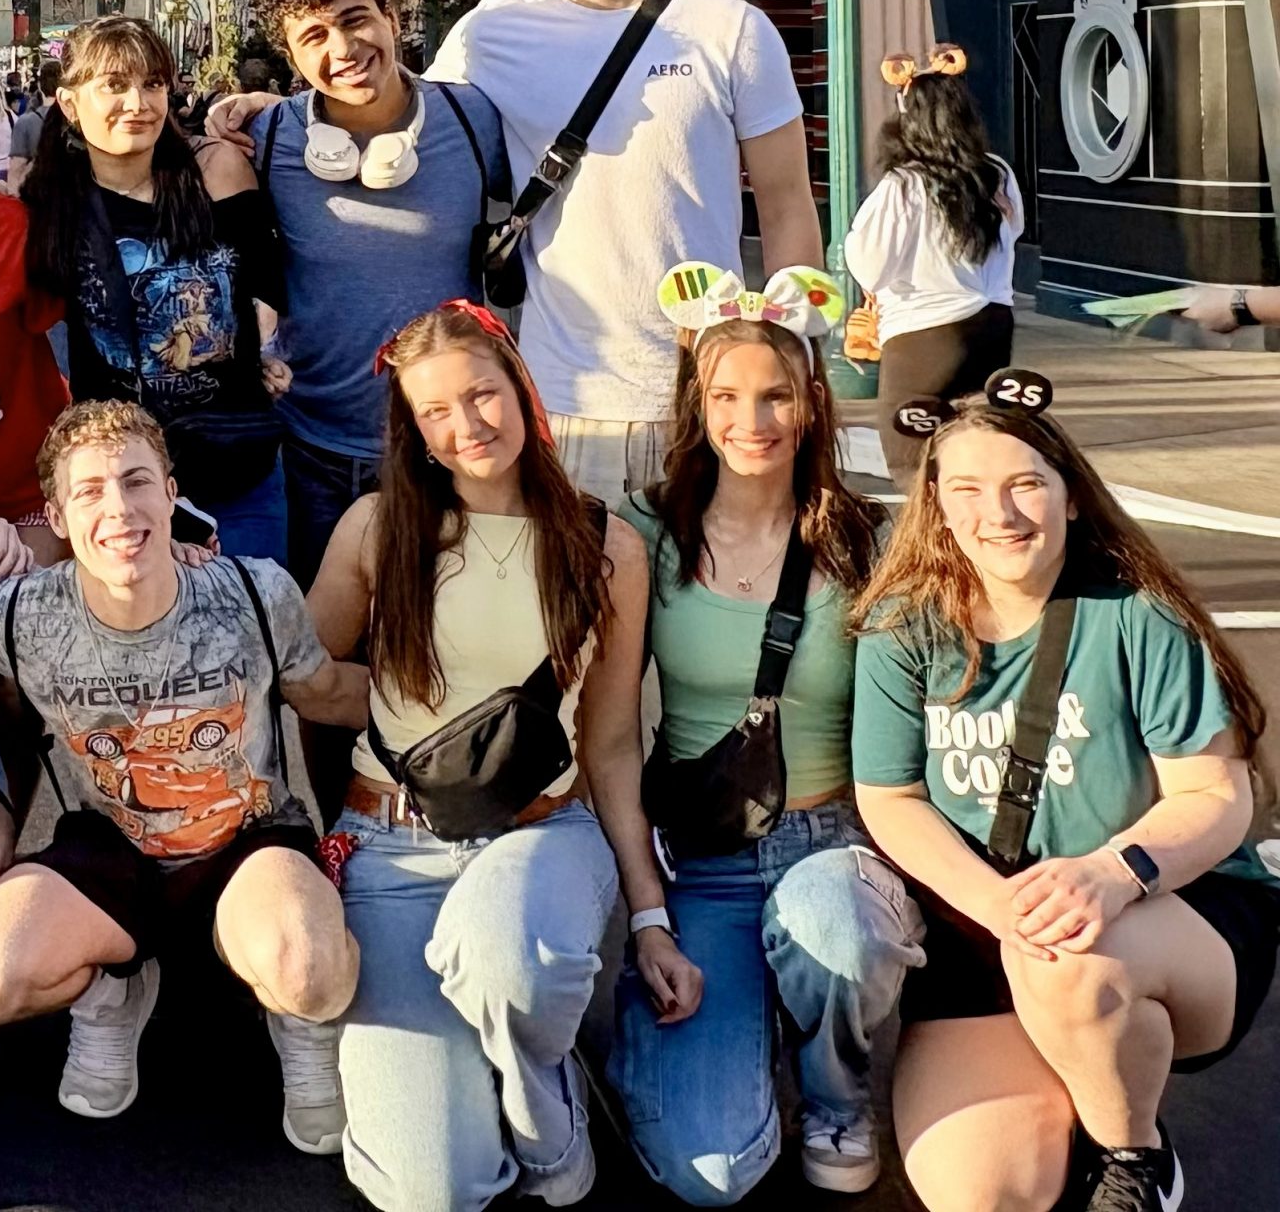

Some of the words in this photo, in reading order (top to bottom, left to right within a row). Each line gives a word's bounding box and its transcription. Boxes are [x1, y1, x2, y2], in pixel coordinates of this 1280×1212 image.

[647, 63, 692, 77] AERO
[52, 659, 247, 707] MCQUEEN
[153, 724, 184, 747] 95
[924, 699, 1017, 750] Boo
[1055, 692, 1091, 739] &
